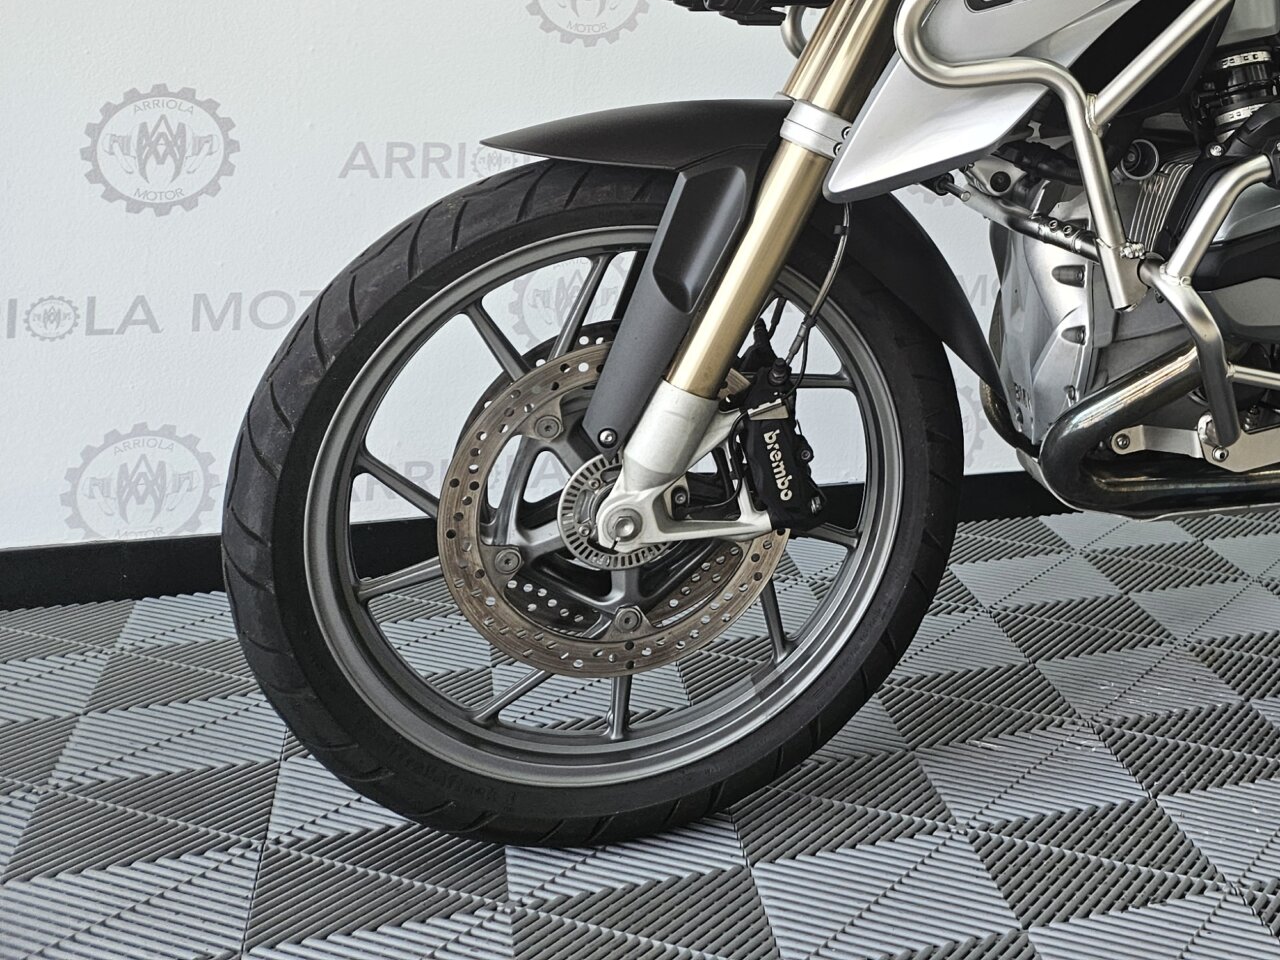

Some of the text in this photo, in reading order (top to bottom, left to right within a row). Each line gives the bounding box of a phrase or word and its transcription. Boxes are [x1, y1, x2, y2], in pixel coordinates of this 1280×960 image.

[566, 20, 608, 34] MOTOR
[133, 98, 194, 115] ARRIOLA
[133, 188, 185, 201] MOTOR
[113, 438, 175, 456] ARRIOLA
[763, 429, 793, 501] brembo
